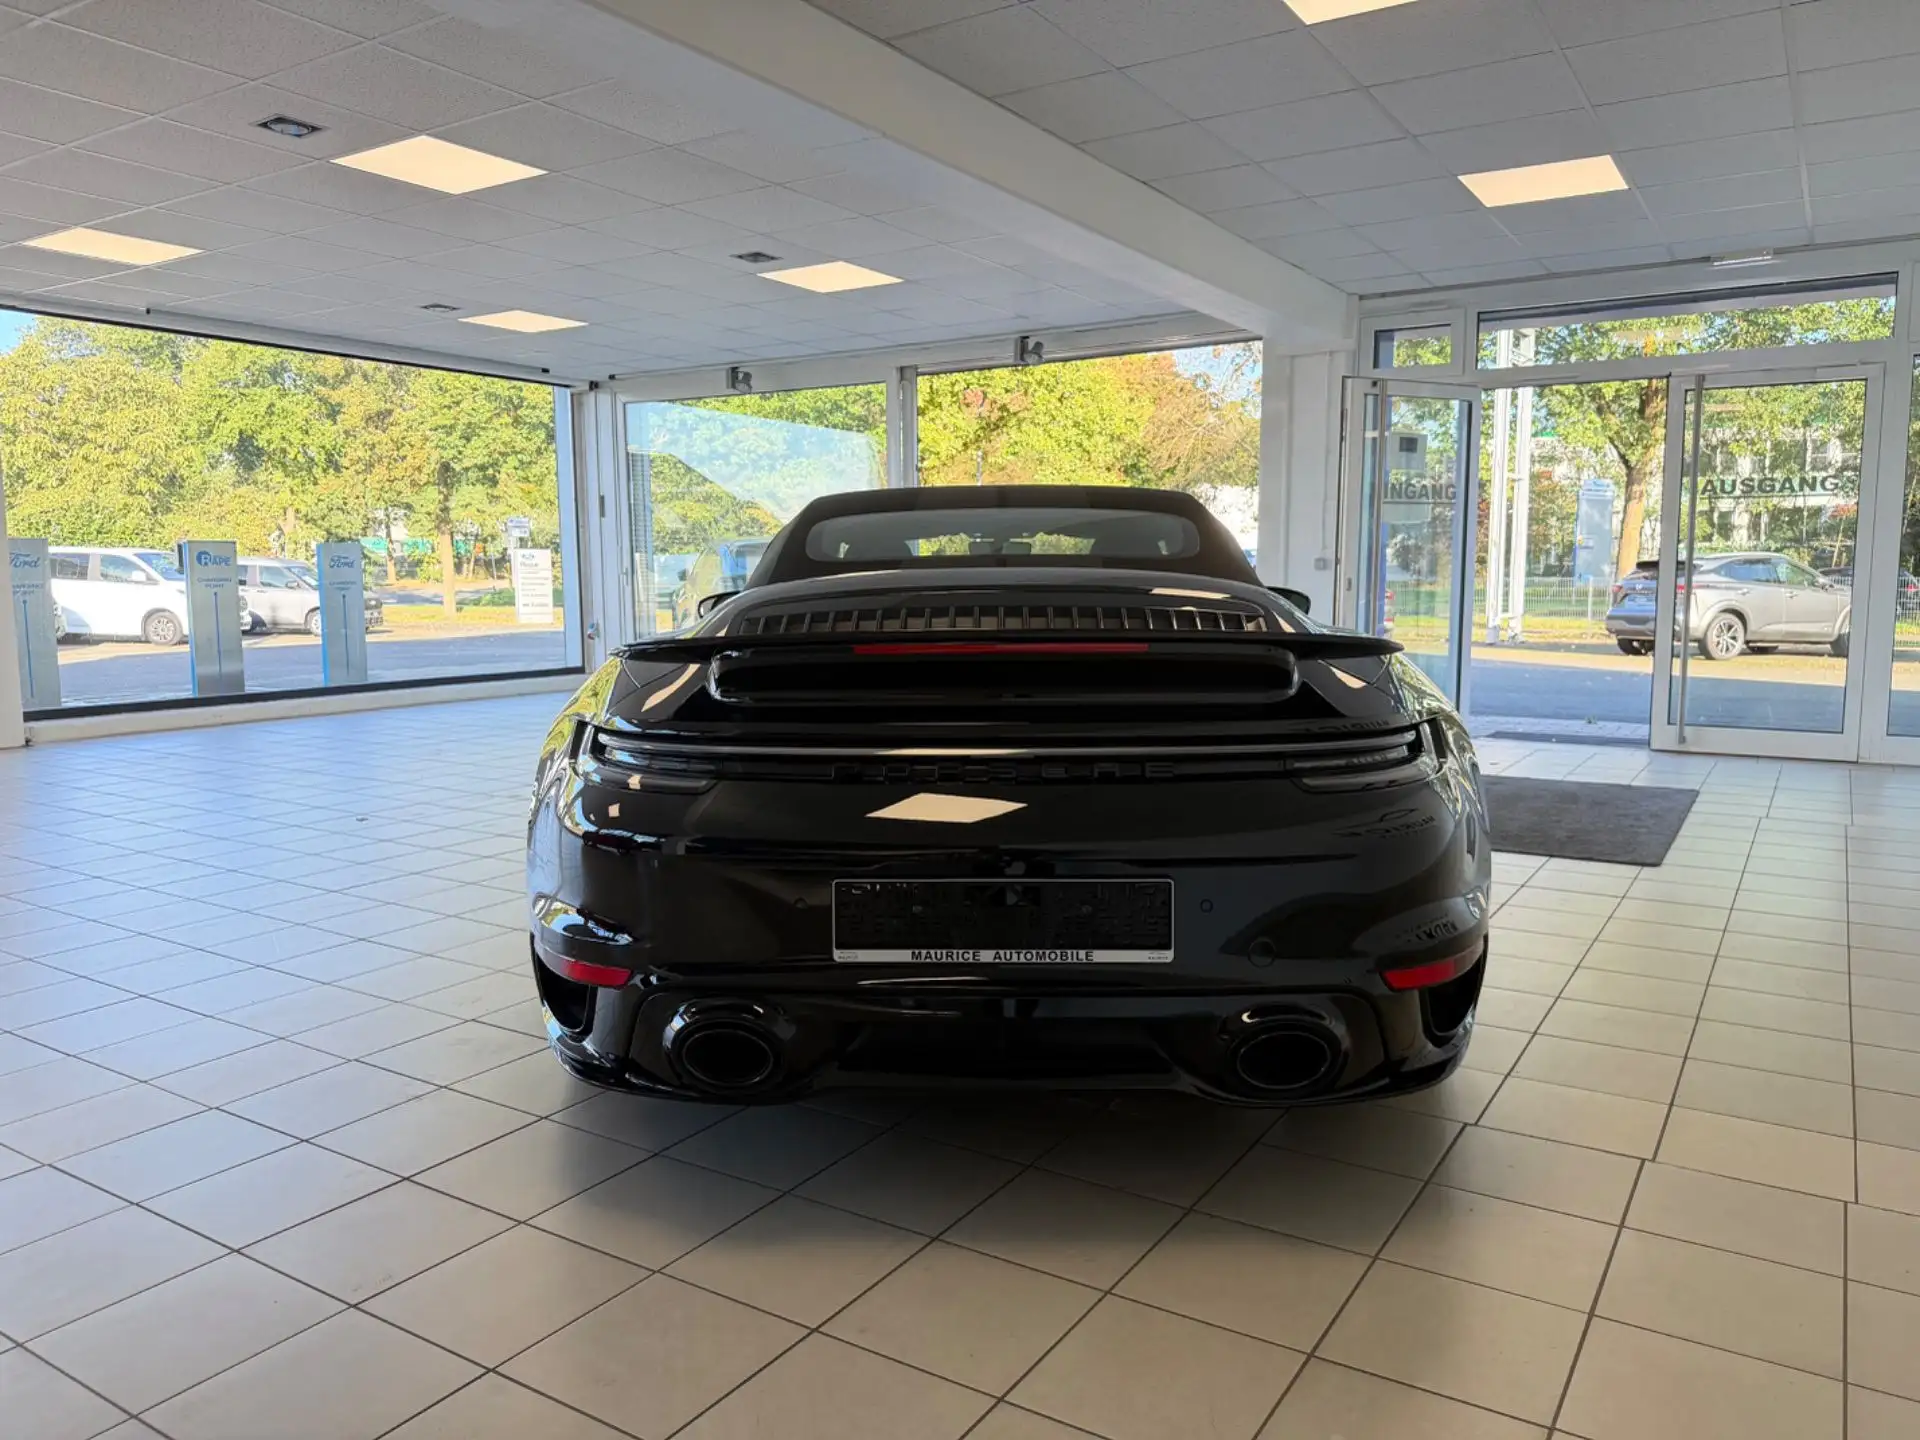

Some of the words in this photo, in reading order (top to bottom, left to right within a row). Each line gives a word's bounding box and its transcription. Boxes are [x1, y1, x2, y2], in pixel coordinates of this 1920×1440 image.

[1383, 483, 1457, 500] INGANG
[1701, 475, 1840, 496] AUSGANG
[329, 555, 357, 568] Ford
[911, 950, 981, 962] MAURICE
[993, 950, 1094, 962] AUTOMOBILE
